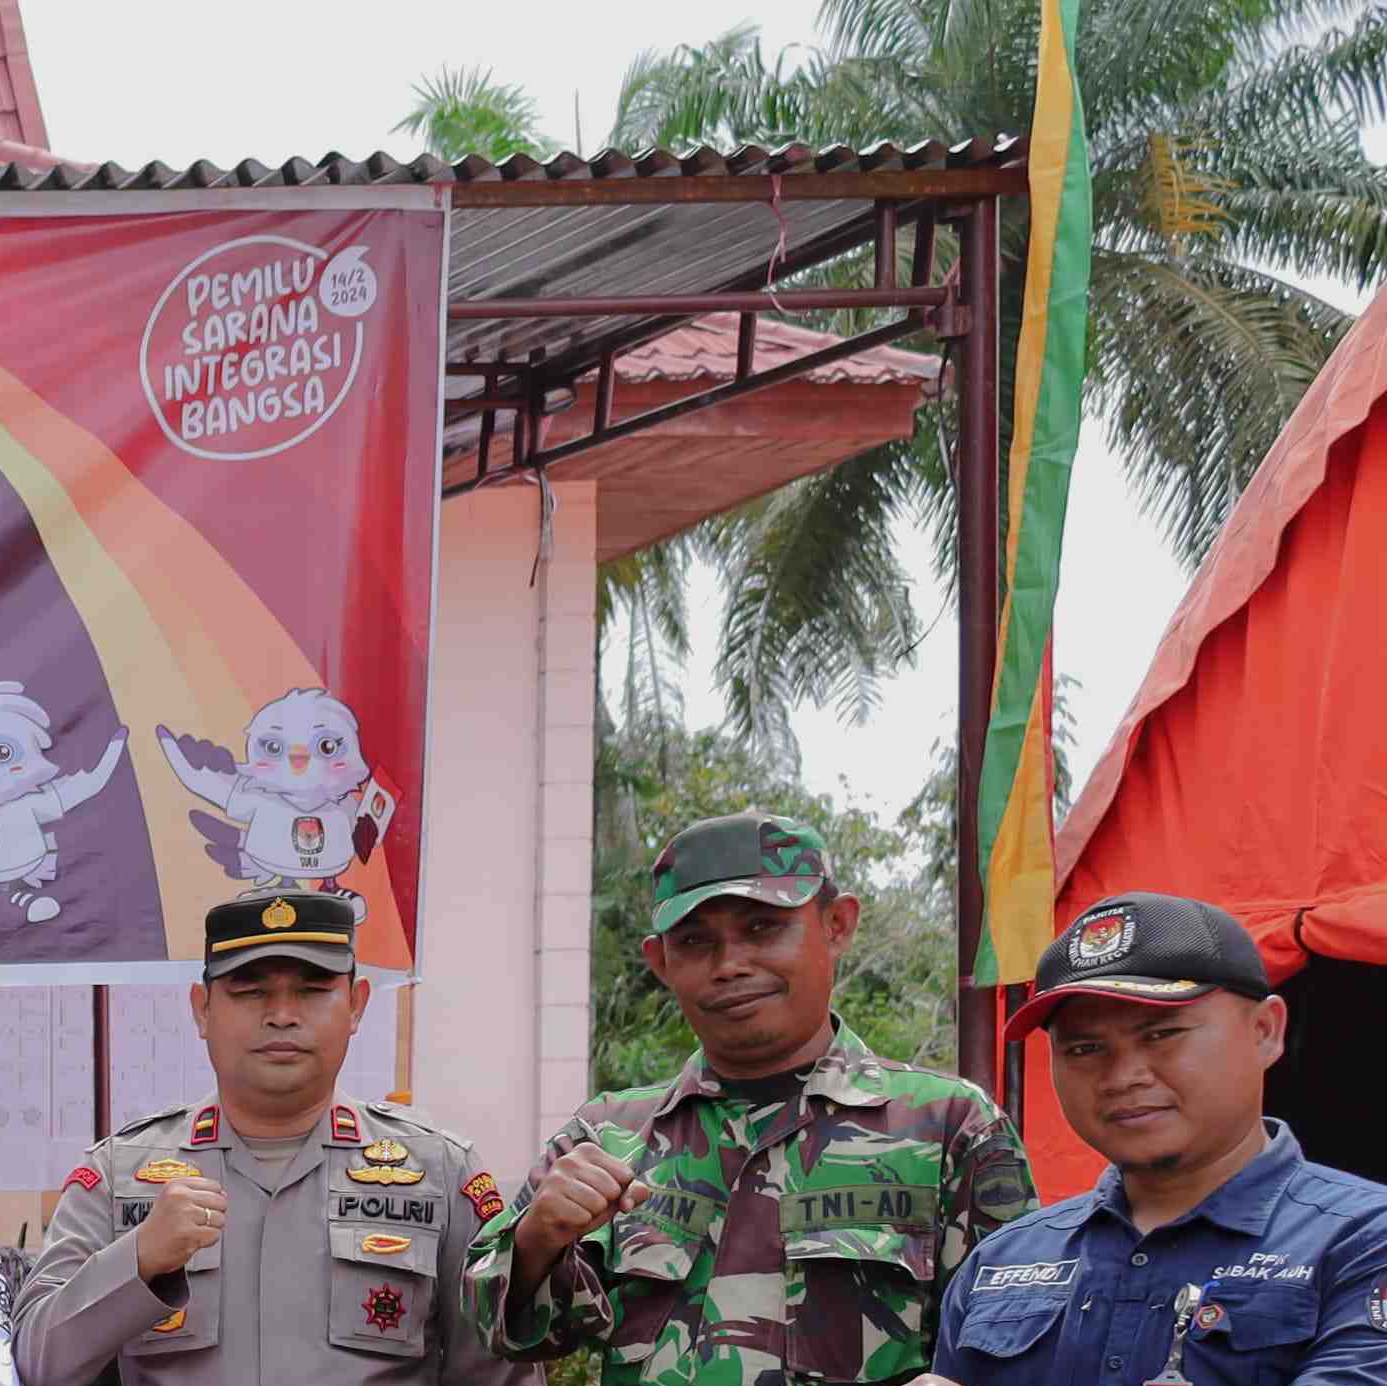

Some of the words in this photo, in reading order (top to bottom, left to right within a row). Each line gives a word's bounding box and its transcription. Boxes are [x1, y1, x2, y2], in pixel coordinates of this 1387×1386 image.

[186, 256, 315, 317] PEMILU
[330, 268, 366, 290] 14/2
[331, 286, 368, 307] 2024
[182, 295, 319, 356] SARANA
[163, 331, 341, 401] INTEGRASI
[181, 375, 325, 440] BANGSA
[338, 1196, 434, 1224] POLRI
[797, 1190, 912, 1222] TNI-AD
[989, 1264, 1065, 1286] EFFENDI
